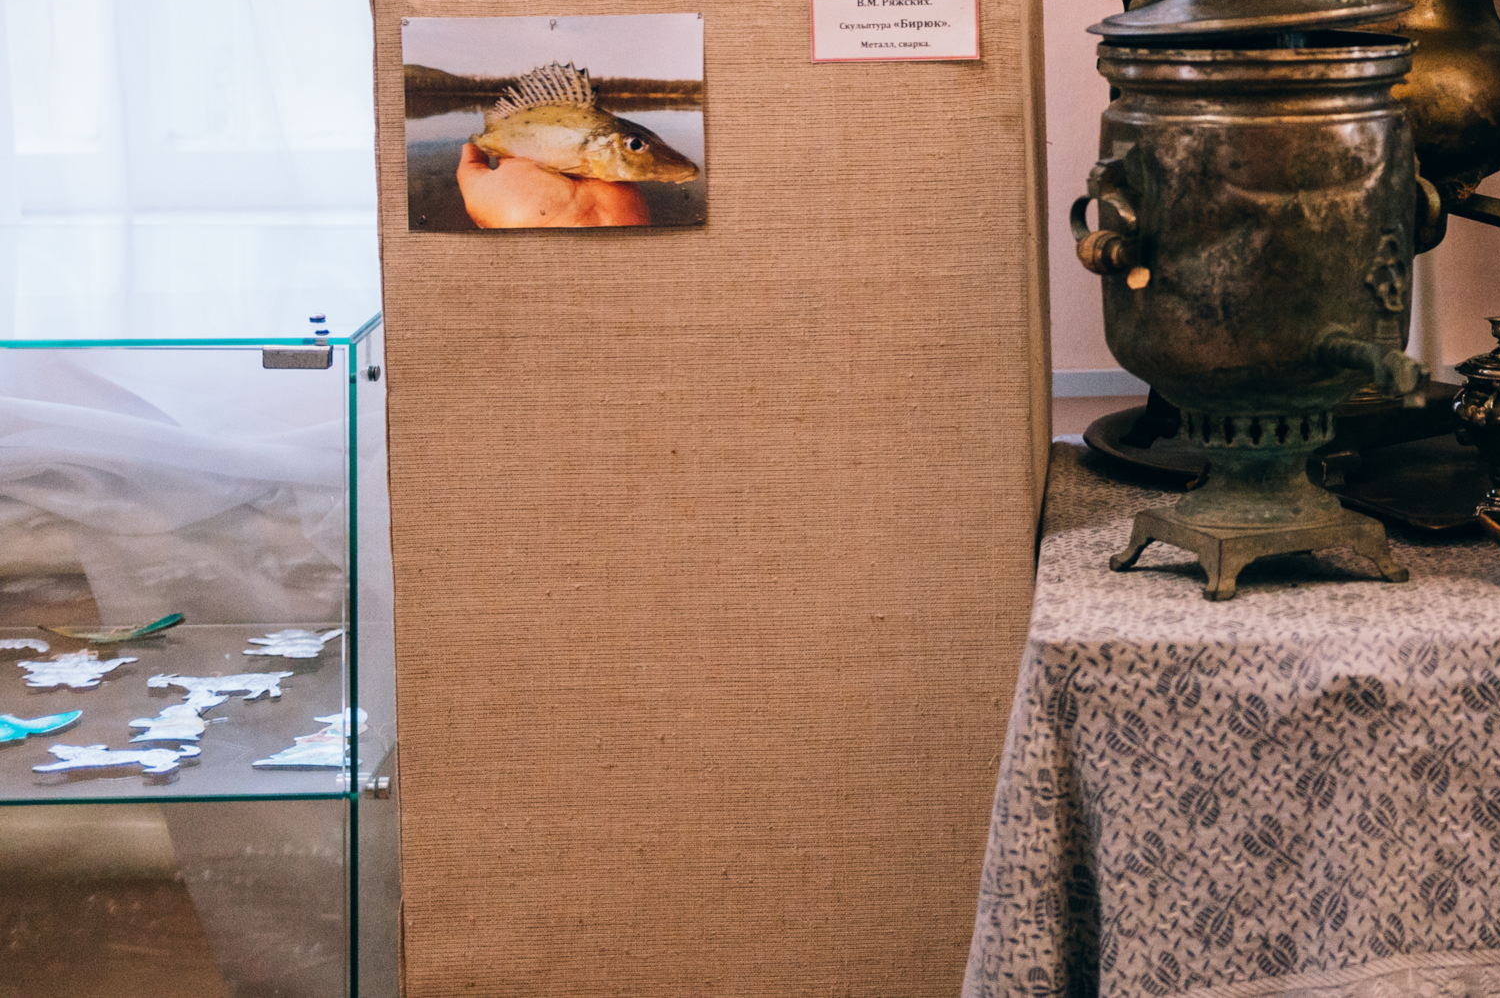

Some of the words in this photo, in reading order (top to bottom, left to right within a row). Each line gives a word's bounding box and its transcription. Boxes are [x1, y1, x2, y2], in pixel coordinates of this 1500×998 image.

[839, 22, 891, 31] Скульптура
[893, 19, 951, 30] «Бирюк».
[861, 41, 897, 49] Металл,
[898, 41, 931, 49] сварка.
